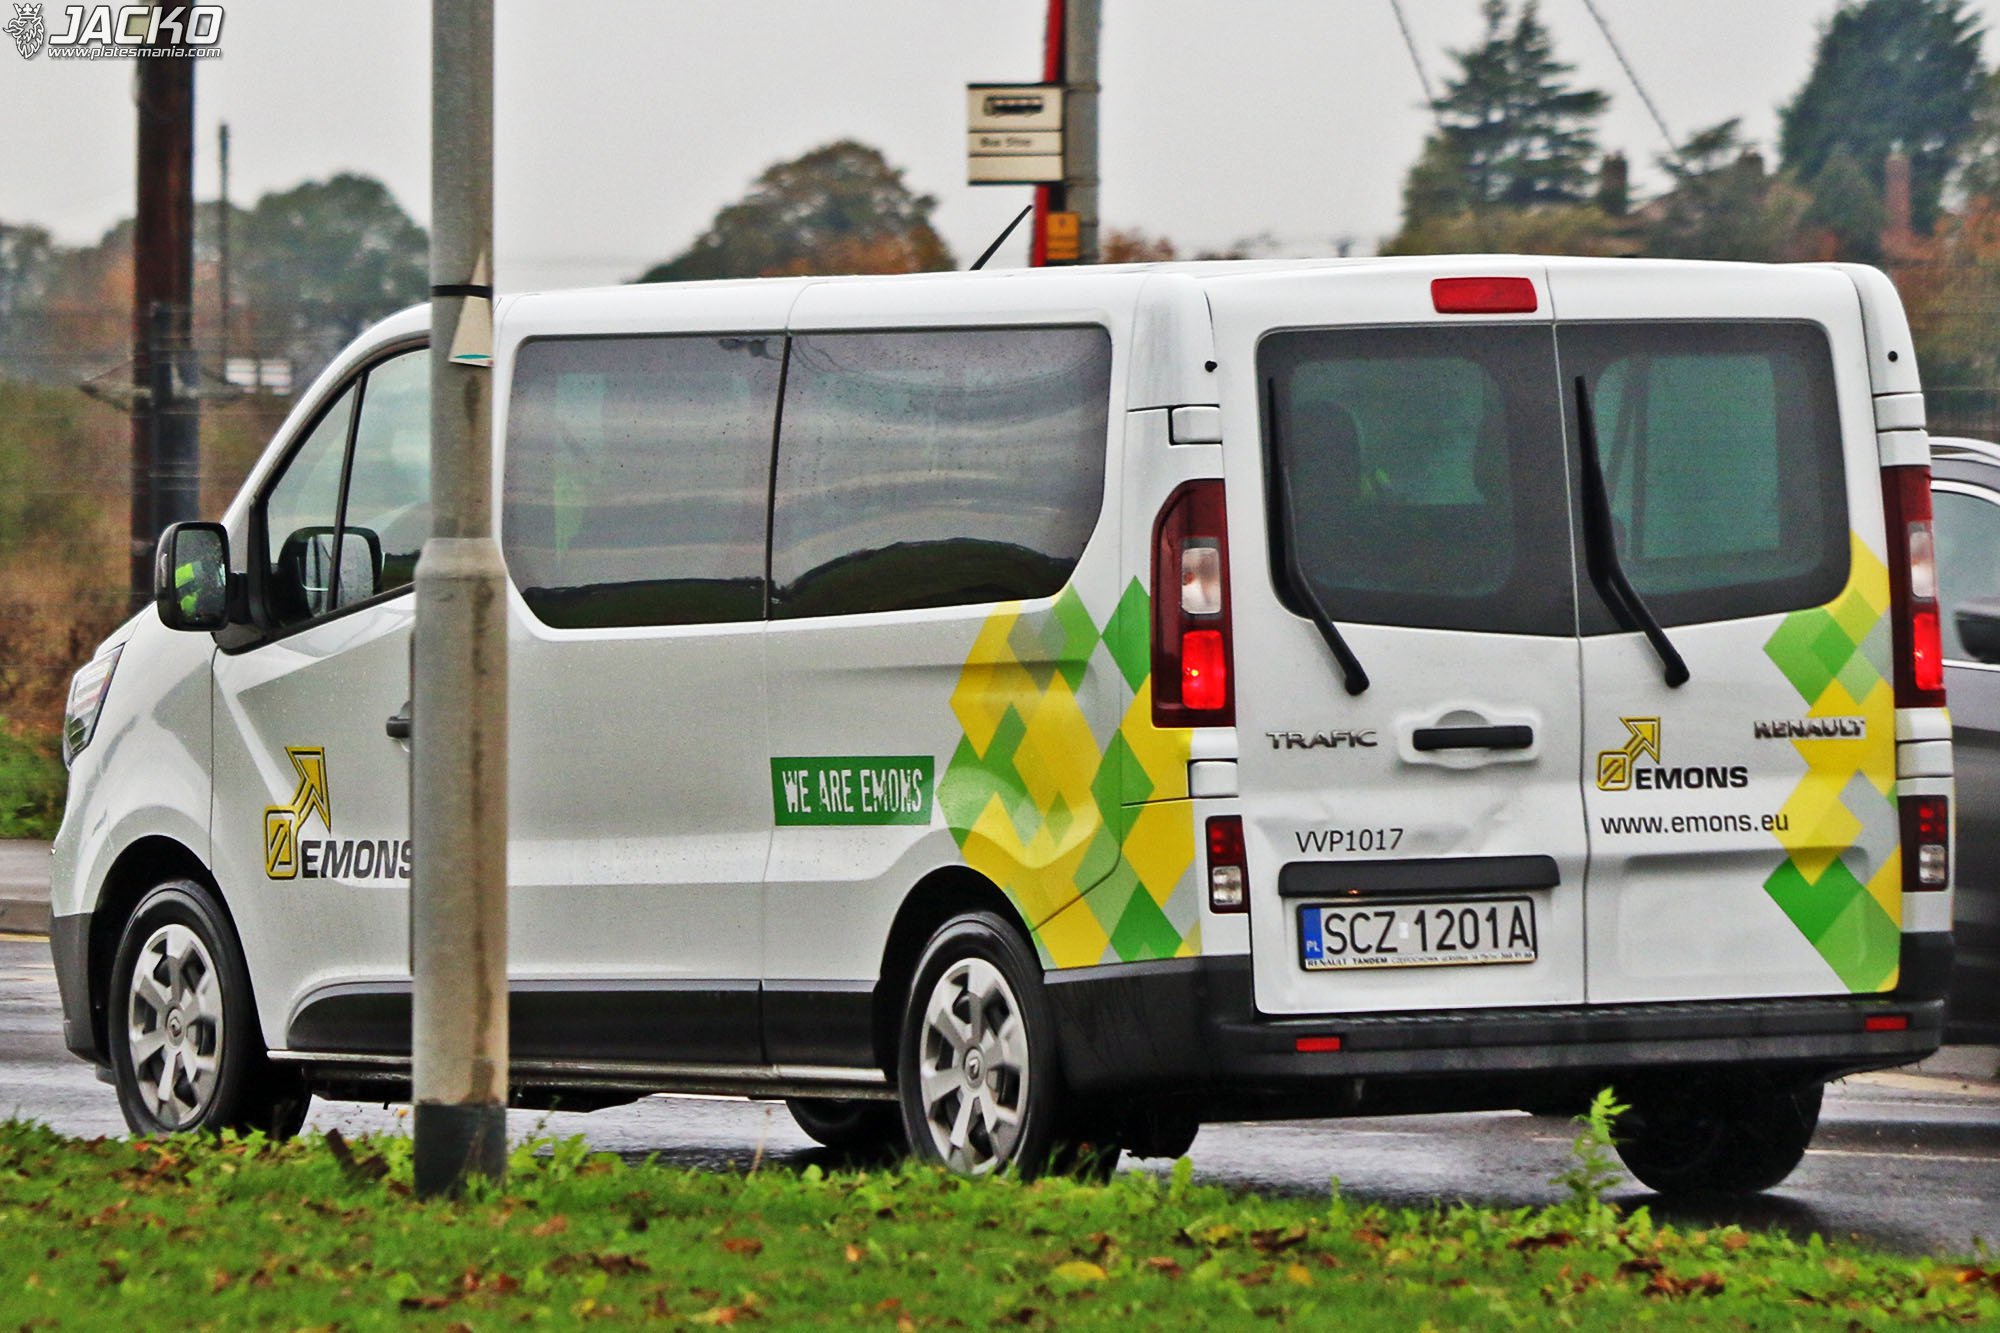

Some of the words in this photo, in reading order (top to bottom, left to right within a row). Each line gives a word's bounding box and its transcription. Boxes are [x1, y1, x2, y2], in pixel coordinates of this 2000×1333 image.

[1753, 718, 1866, 739] RENAULT
[1266, 730, 1378, 749] TRAFIC
[1636, 766, 1748, 790] EMONS
[782, 770, 812, 813] WE
[818, 769, 855, 813] ARE
[859, 768, 923, 813] EMONS
[1601, 813, 1789, 834] www.emons.eu
[1324, 911, 1399, 954] SCZ
[1414, 905, 1531, 952] 1201A
[1306, 939, 1321, 952] PL
